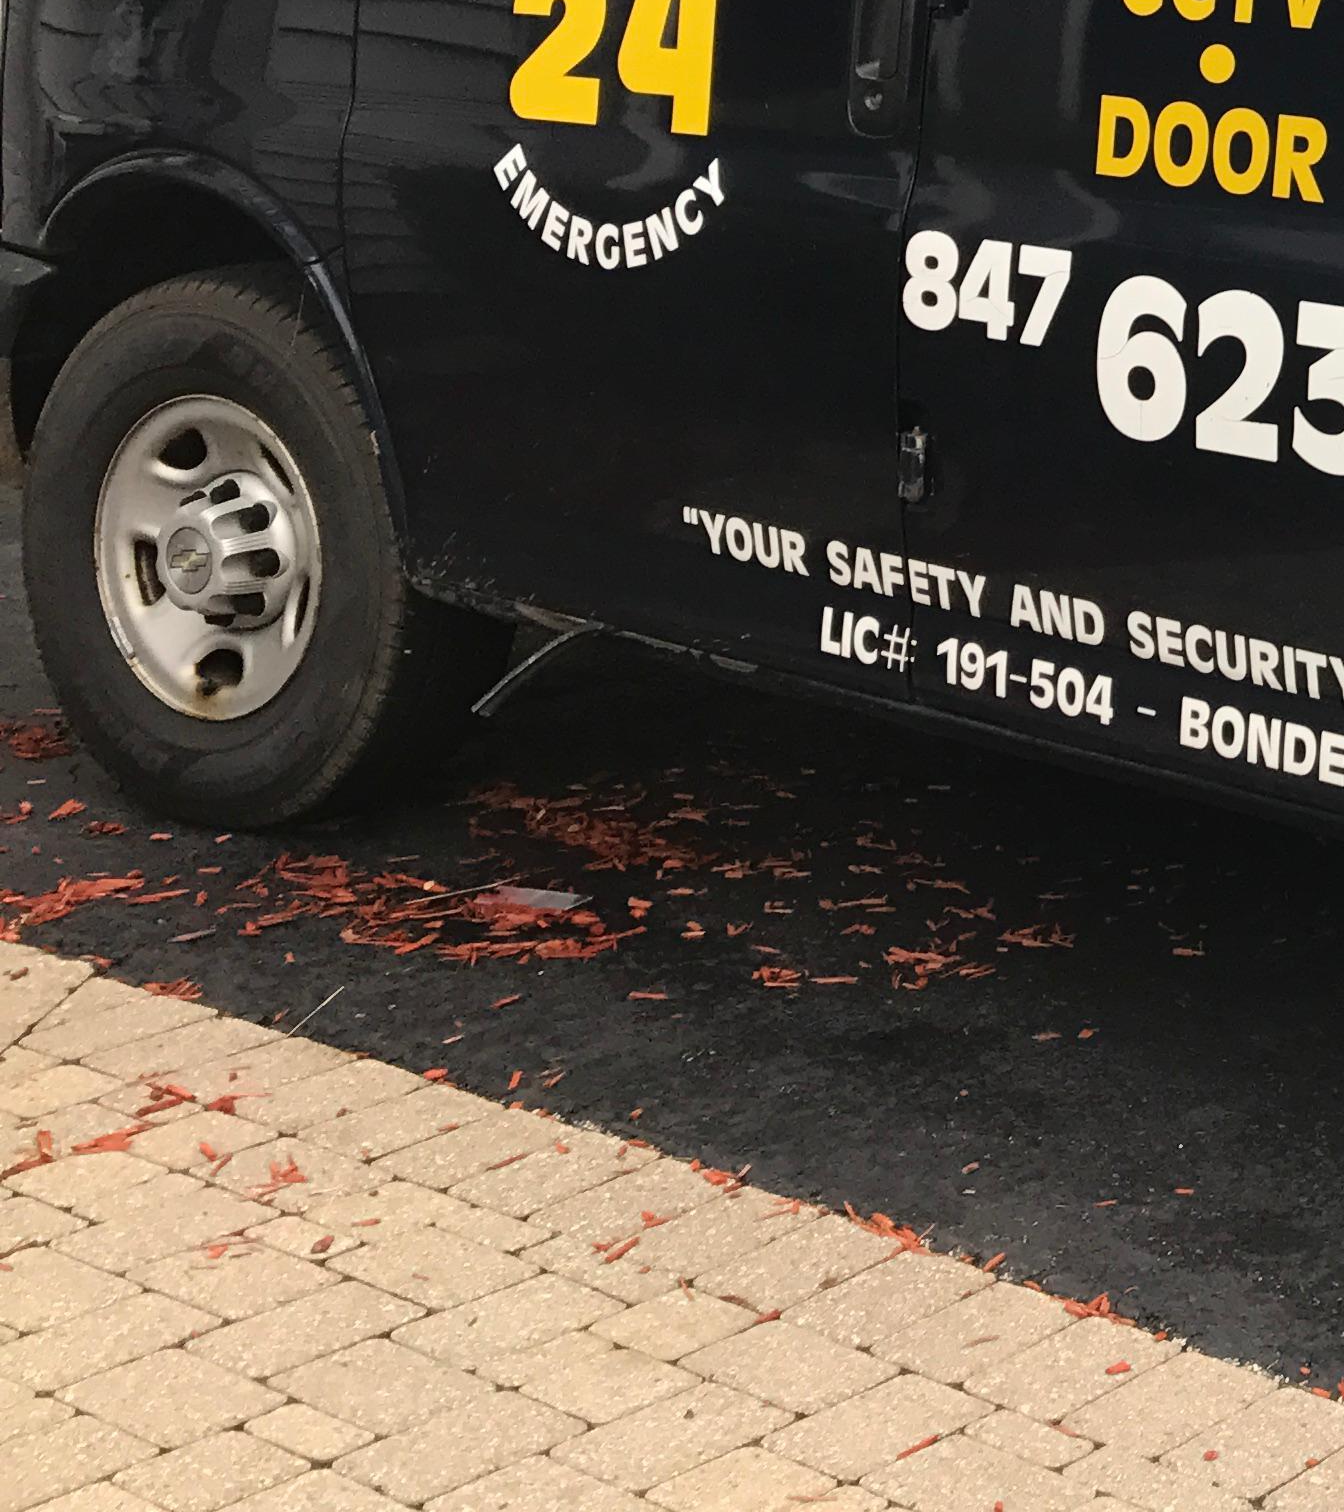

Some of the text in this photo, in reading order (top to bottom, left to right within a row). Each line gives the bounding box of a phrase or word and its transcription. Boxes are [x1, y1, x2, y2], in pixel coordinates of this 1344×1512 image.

[492, 143, 726, 271] EMERGENCY
[1095, 95, 1329, 204] DOOR
[902, 229, 1073, 347] 847
[683, 506, 810, 577] "YOUR
[826, 540, 986, 618] SAFETY
[1010, 584, 1105, 646] AND
[936, 637, 1114, 726] 191-504
